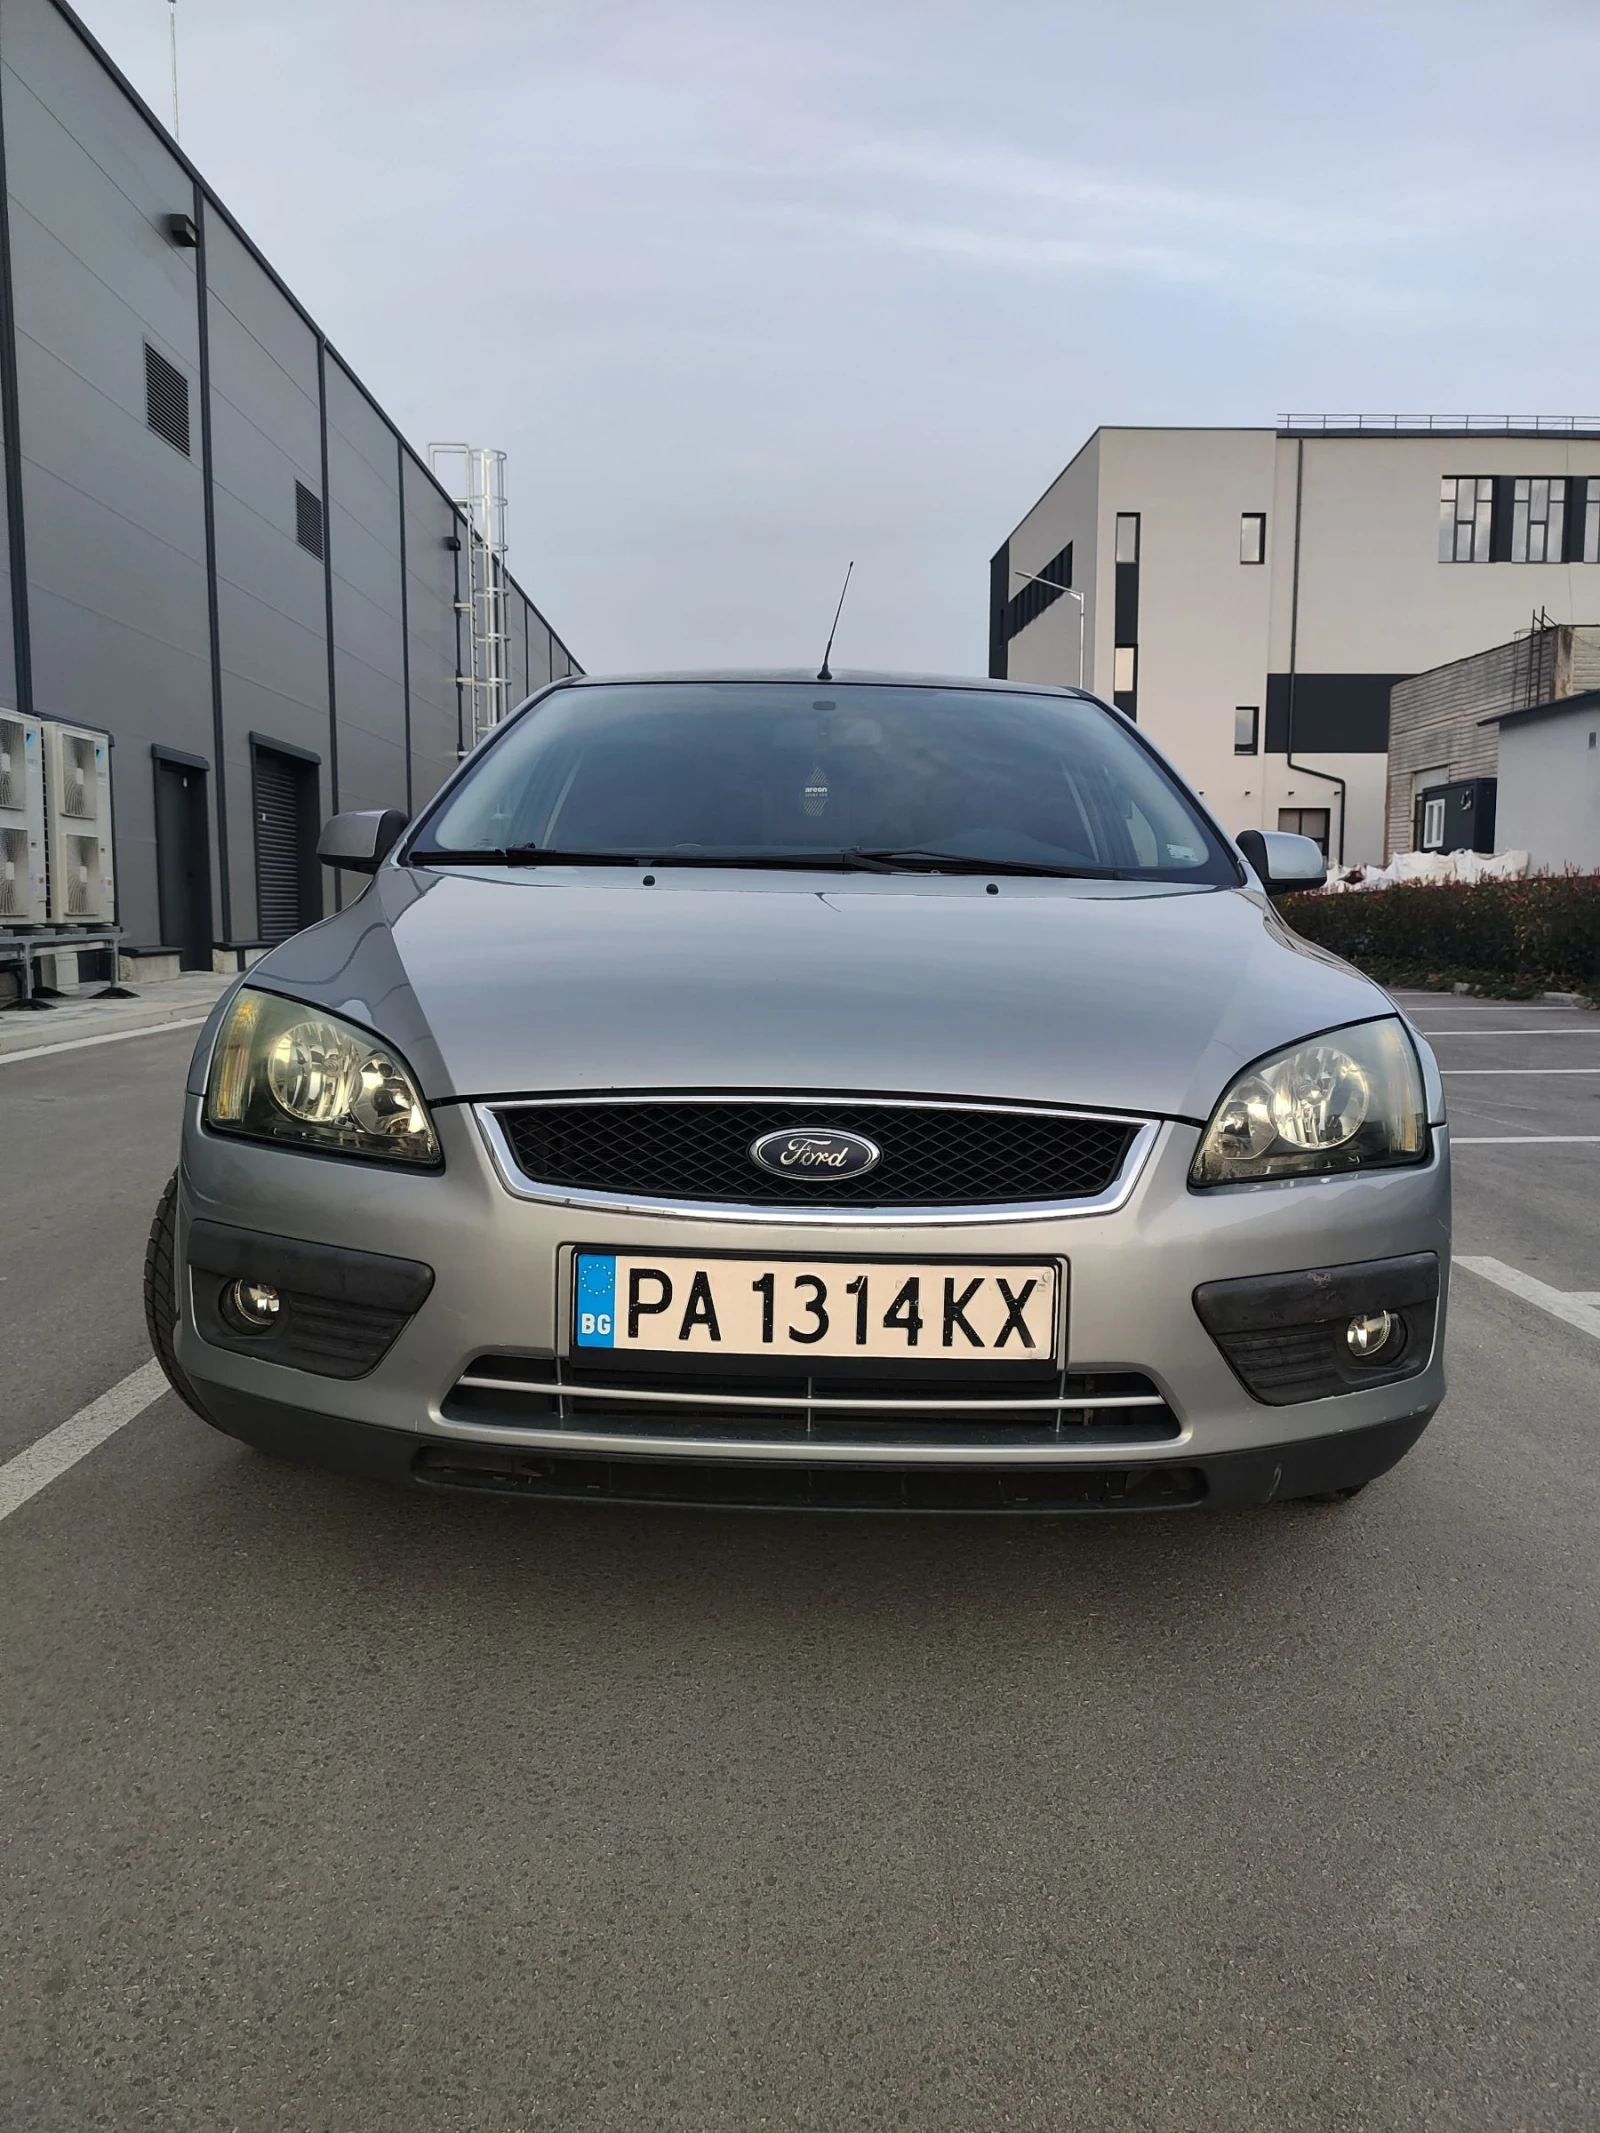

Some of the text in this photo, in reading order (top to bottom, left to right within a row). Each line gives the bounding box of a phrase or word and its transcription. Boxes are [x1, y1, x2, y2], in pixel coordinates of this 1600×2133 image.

[780, 1138, 849, 1168] Ford
[628, 1268, 722, 1341] PA
[581, 1313, 611, 1335] BG
